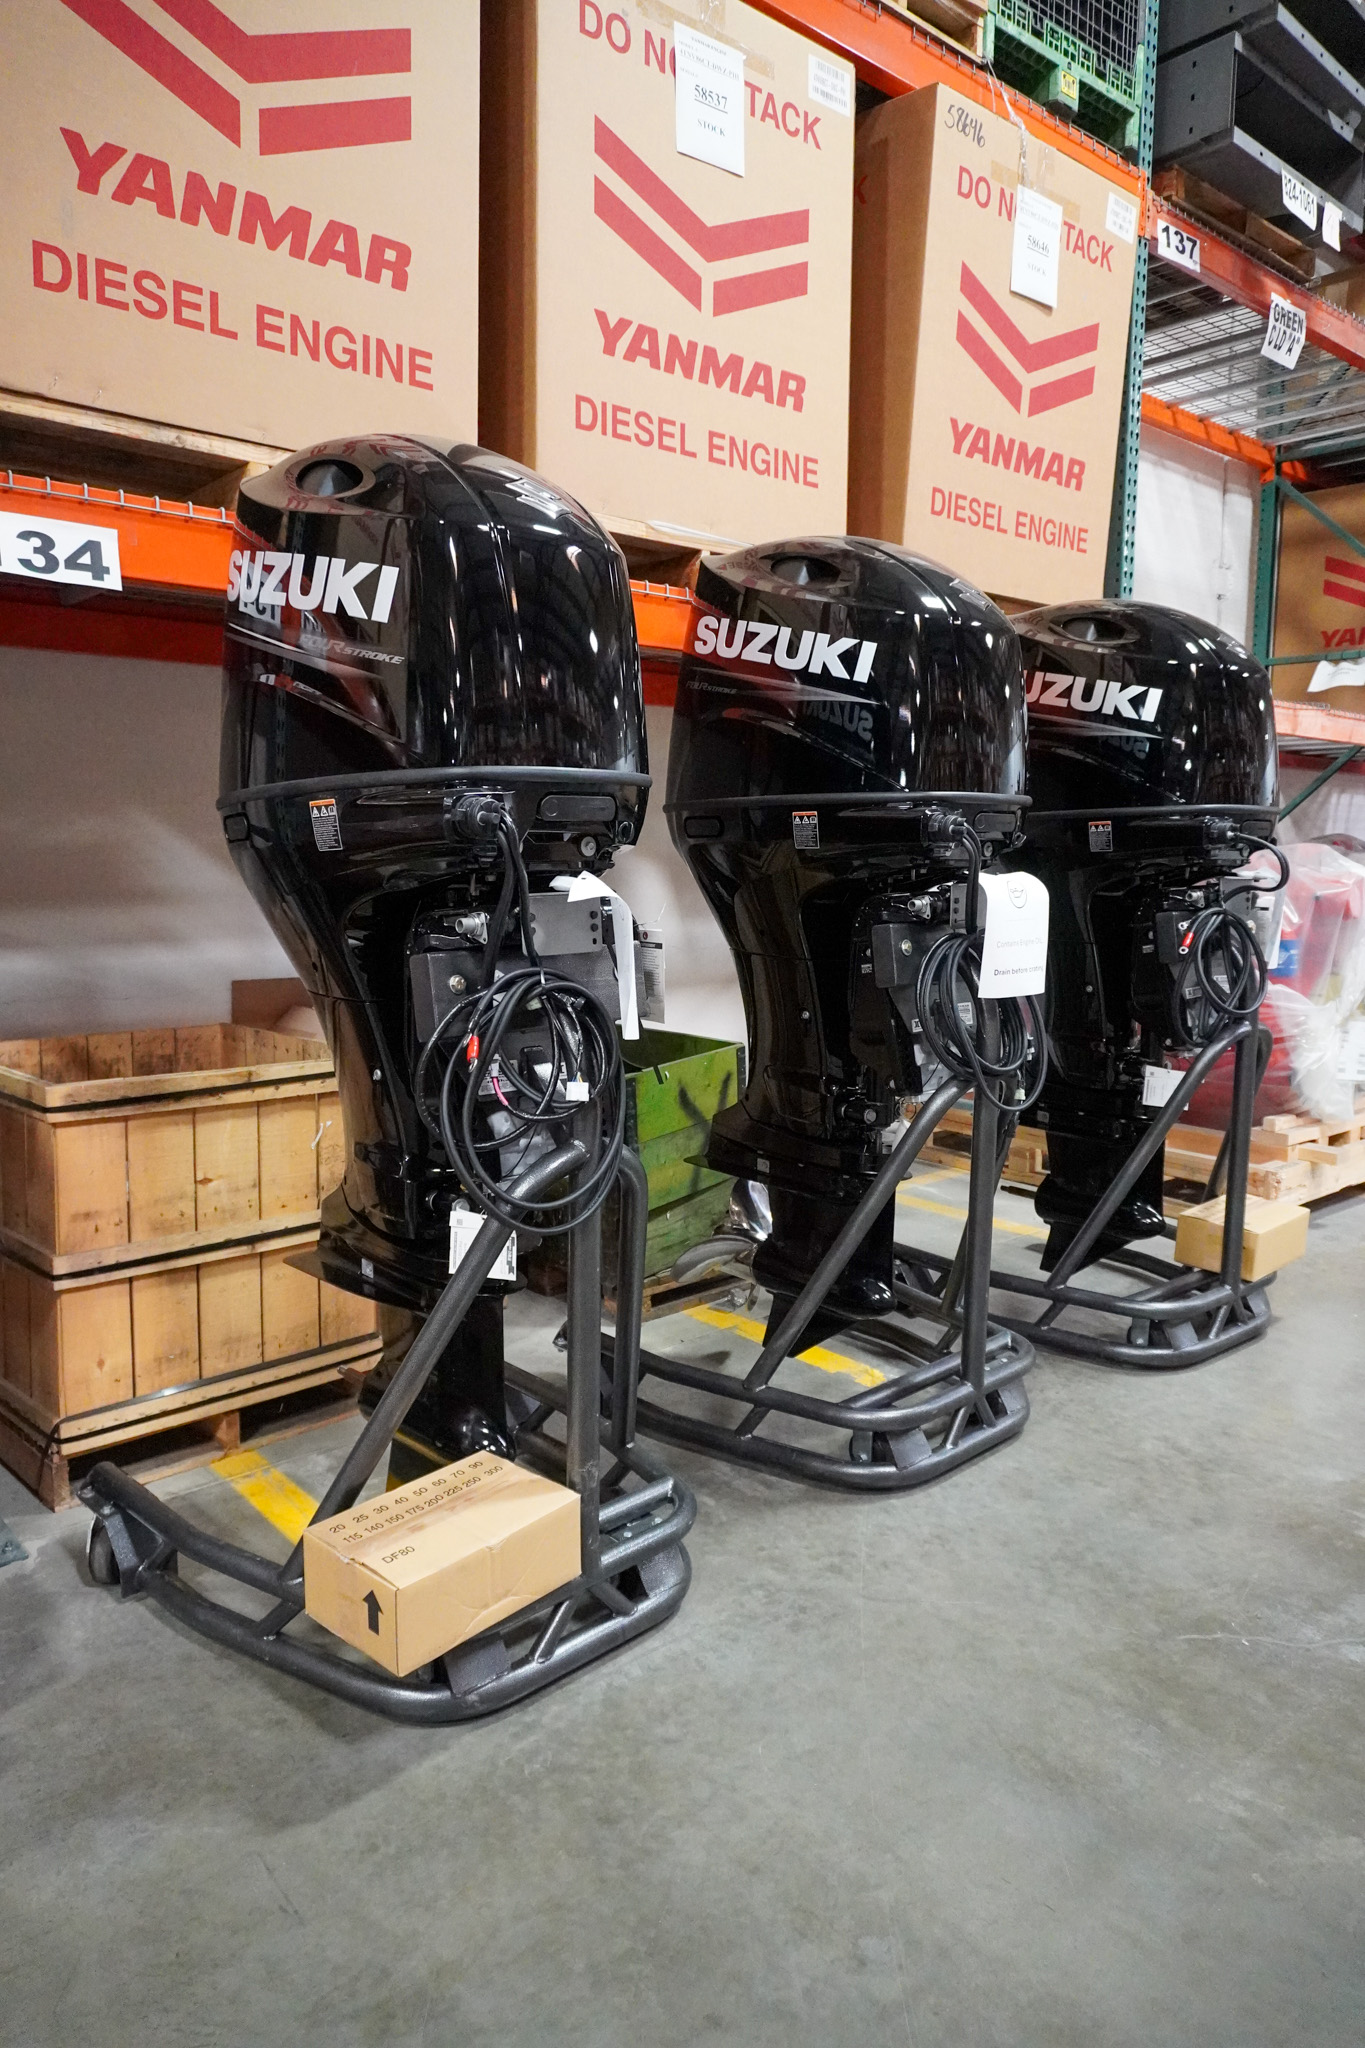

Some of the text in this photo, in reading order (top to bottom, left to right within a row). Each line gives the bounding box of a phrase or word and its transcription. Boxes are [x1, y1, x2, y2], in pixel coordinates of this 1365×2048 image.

[579, 0, 631, 55] DO
[693, 84, 728, 110] 58537
[744, 80, 822, 151] TACK
[697, 118, 726, 137] STOCK
[944, 104, 986, 148] 58646
[60, 127, 412, 292] YANMAR
[957, 165, 991, 208] DO
[1027, 234, 1050, 255] 58646
[1062, 219, 1114, 273] TACK
[1162, 224, 1198, 260] 137
[32, 240, 434, 391] DIESEL ENGINE
[1273, 302, 1304, 335] GREEN
[594, 308, 807, 412] YANMAR
[574, 394, 819, 489] DIESEL ENGINE
[950, 417, 1085, 492] YANMAR
[930, 486, 1089, 555] DIESEL ENGINE
[0, 529, 110, 581] 34
[226, 549, 400, 624] SUZUKI
[694, 615, 878, 683] SUZUKI
[1320, 626, 1365, 649] YA
[1023, 669, 1164, 723] UZUKI
[1011, 967, 1028, 975] before
[329, 1460, 484, 1534] 20 25 30 40 50 60 70 90
[342, 1464, 503, 1544] 115 140 150 175 200 225 250 300
[381, 1544, 416, 1564] DF80
